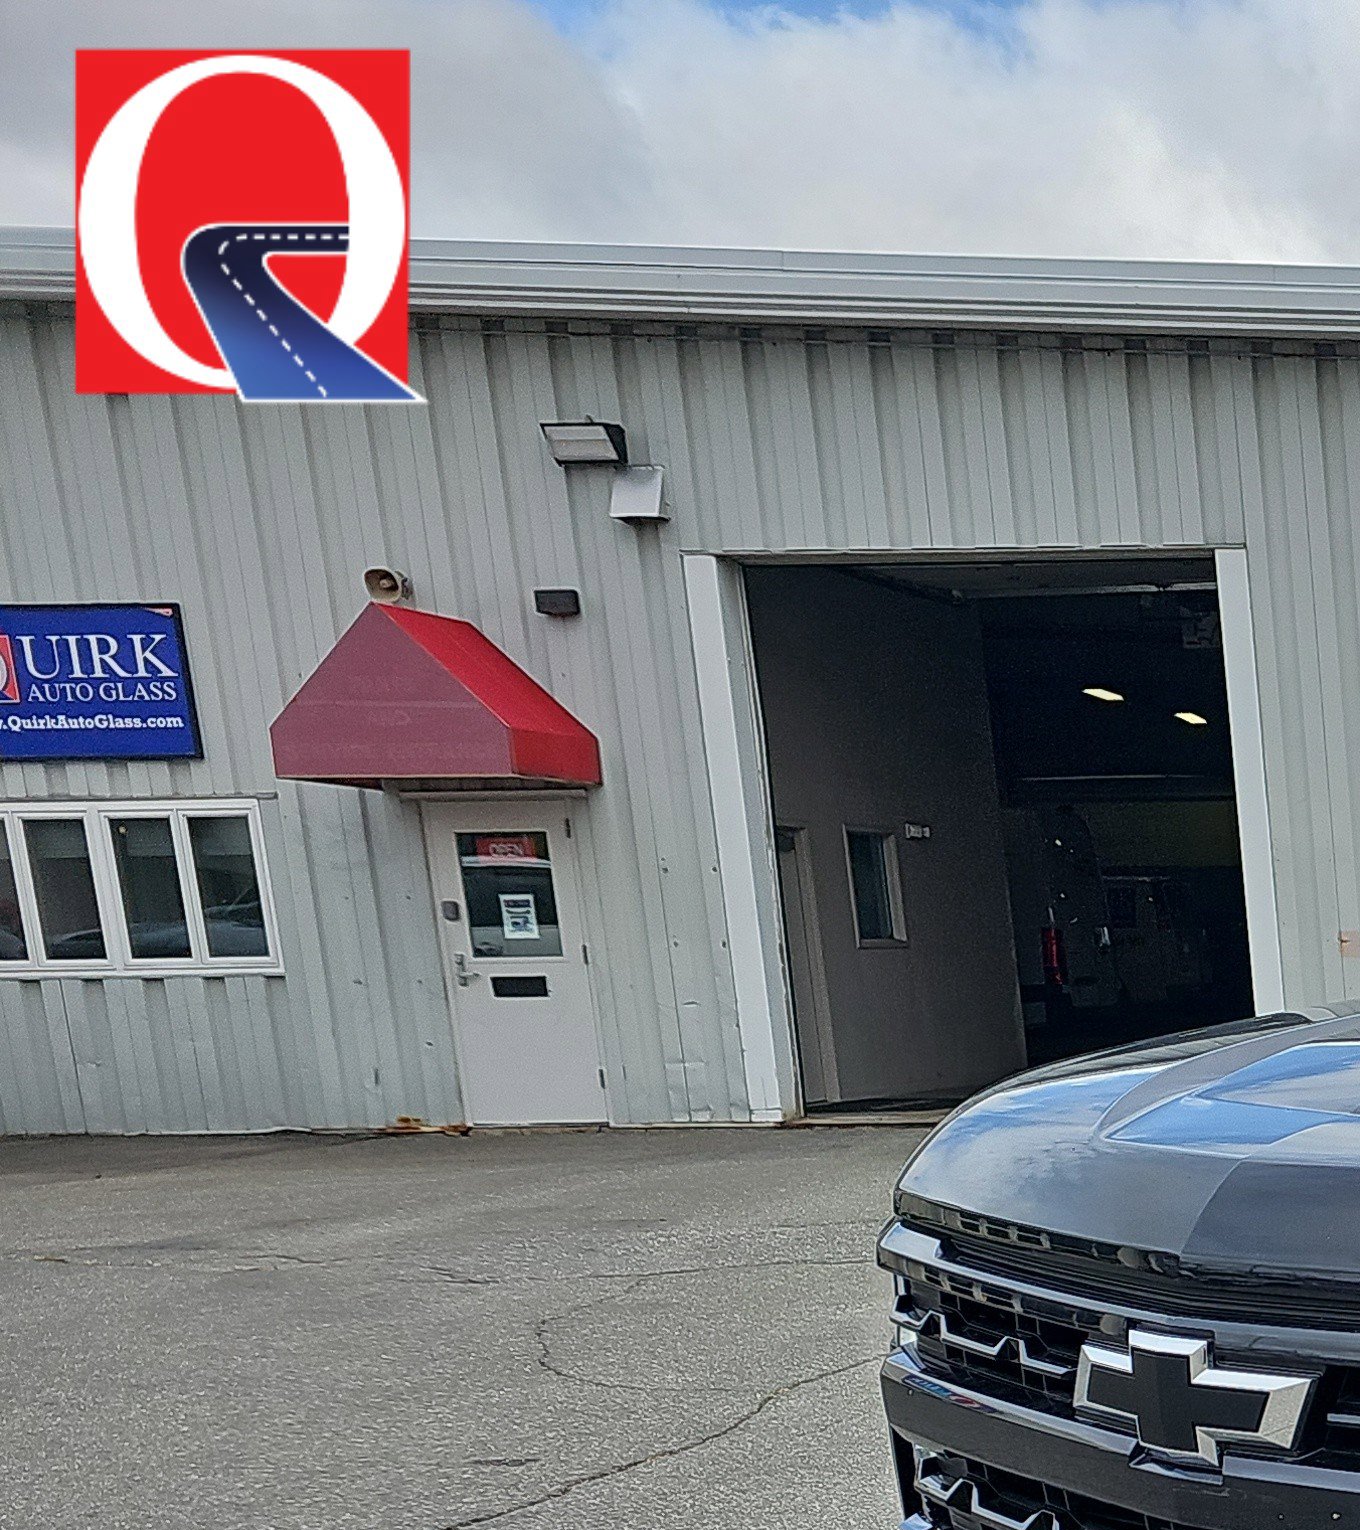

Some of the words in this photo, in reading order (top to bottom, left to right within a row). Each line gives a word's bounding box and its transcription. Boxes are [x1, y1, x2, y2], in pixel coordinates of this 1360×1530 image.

[0, 634, 178, 690] UIRK
[28, 682, 93, 702] AUTO
[99, 681, 177, 702] GLASS
